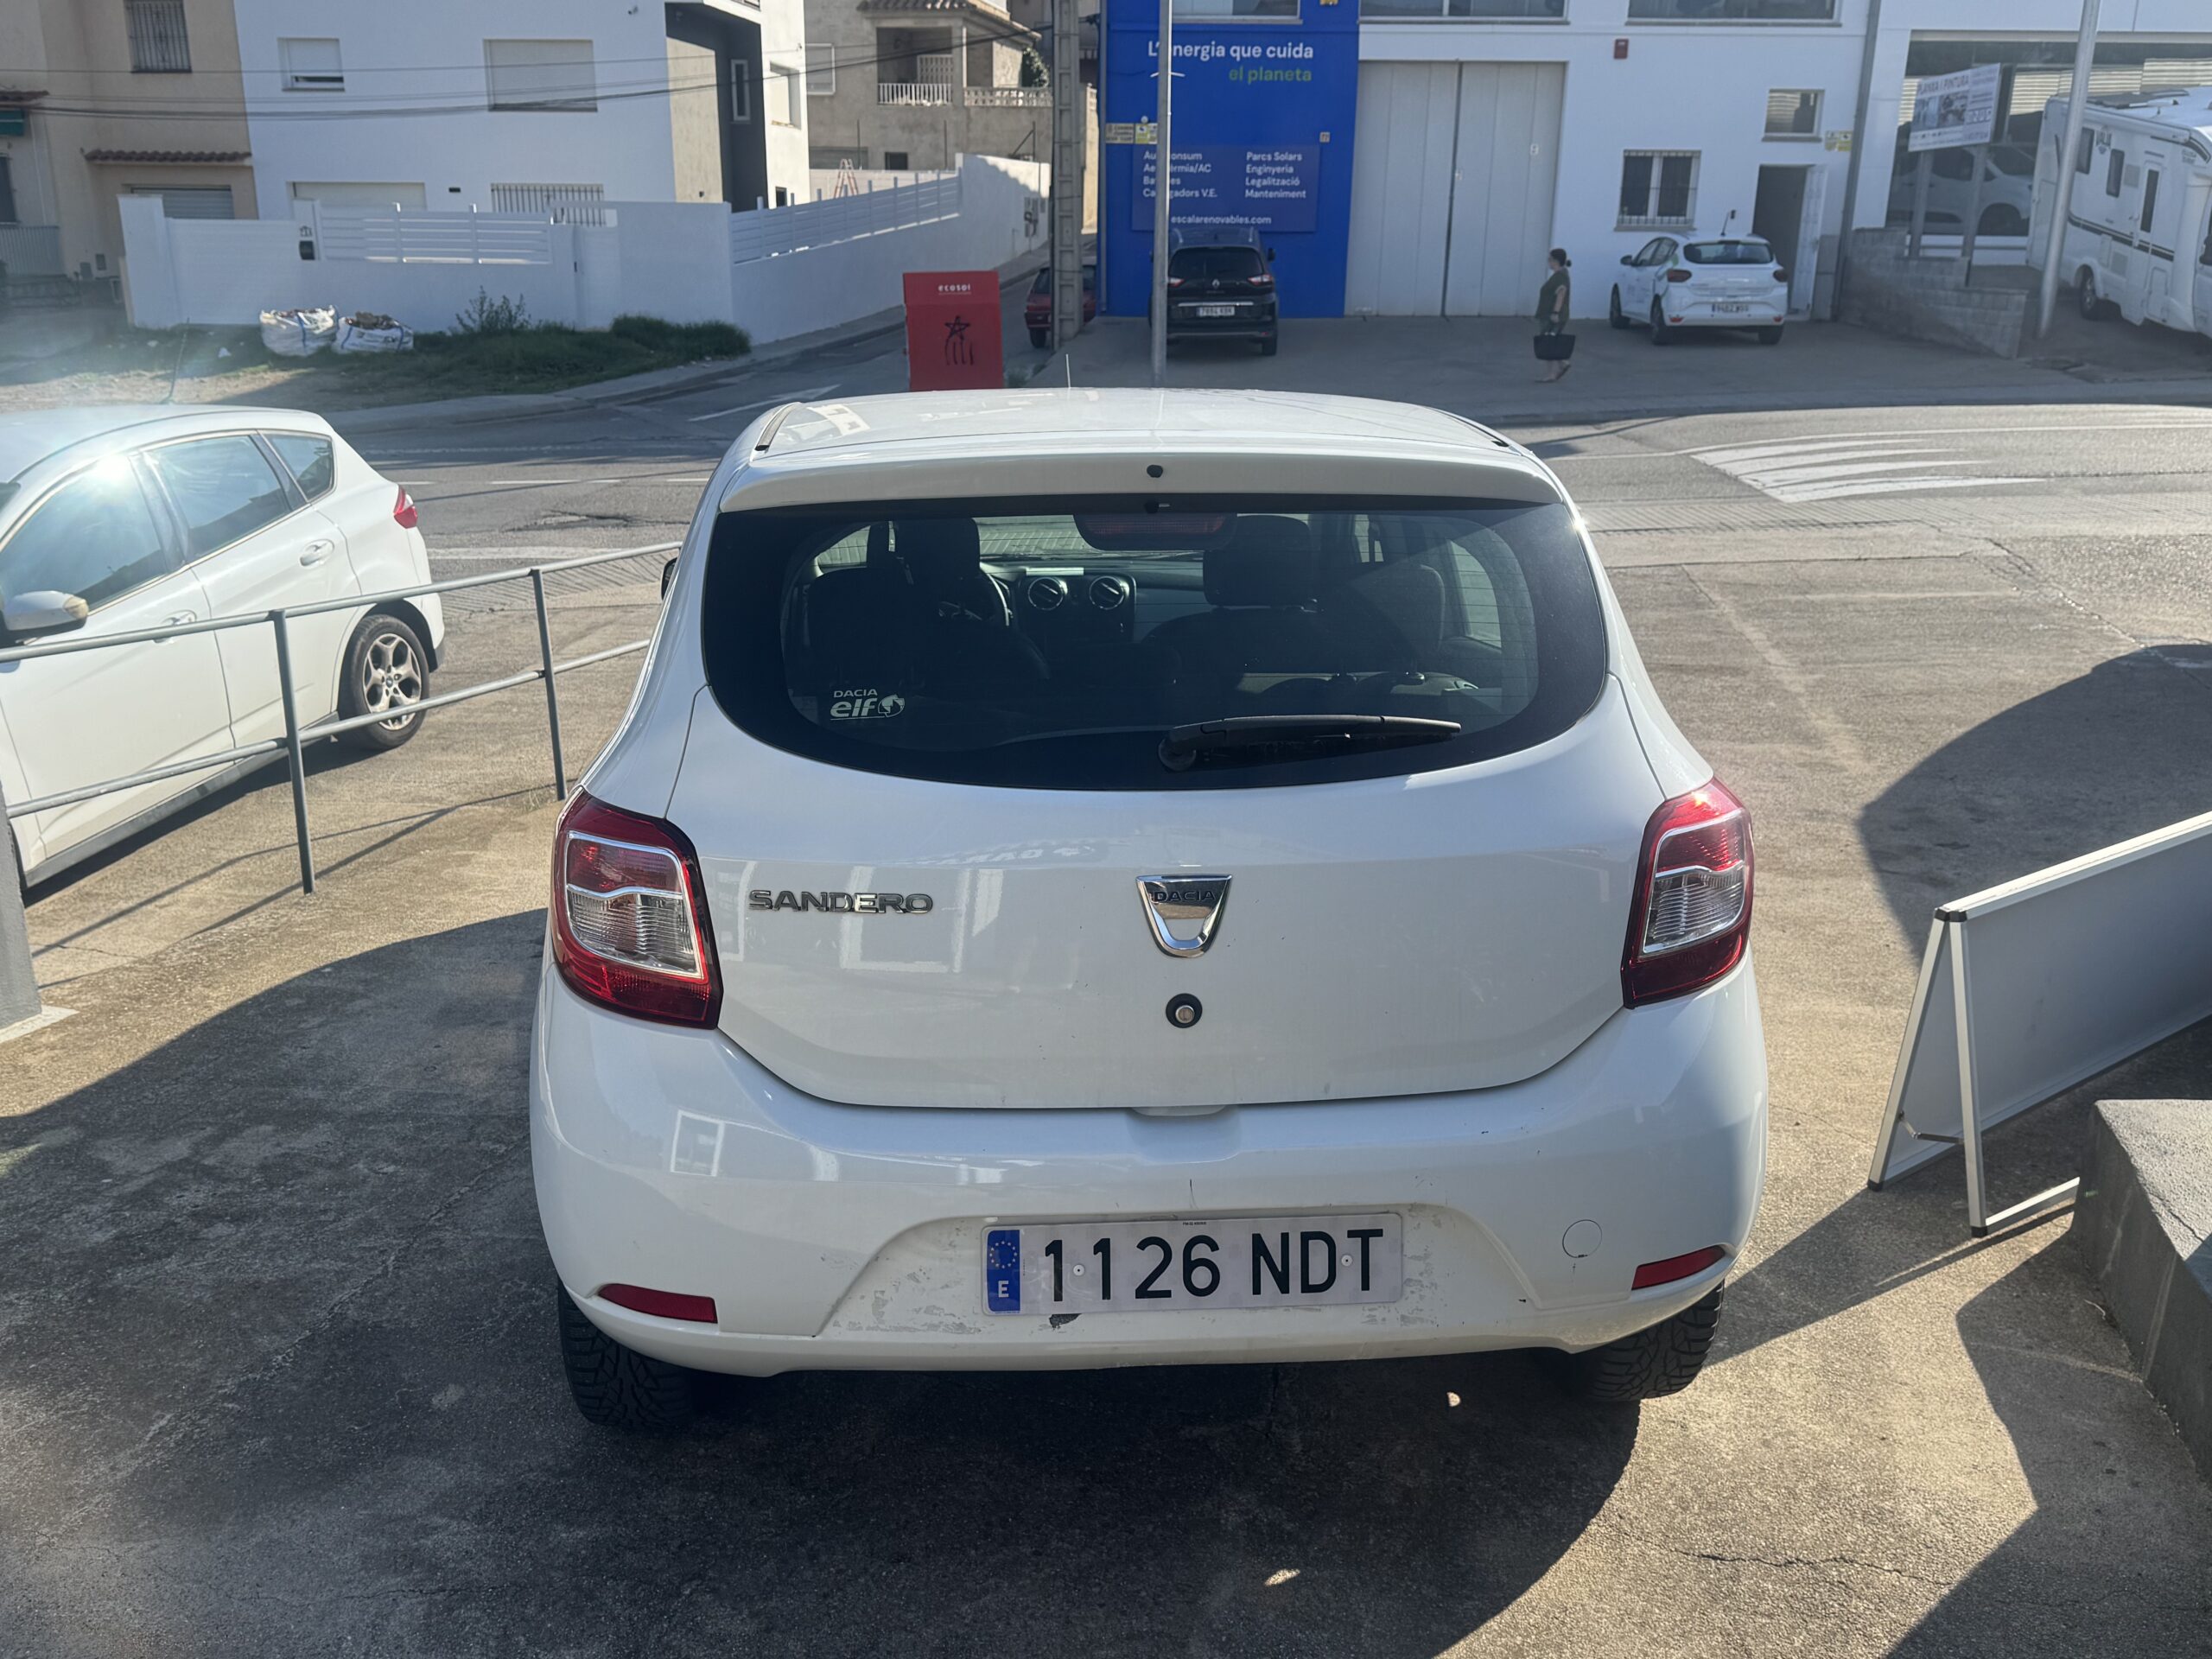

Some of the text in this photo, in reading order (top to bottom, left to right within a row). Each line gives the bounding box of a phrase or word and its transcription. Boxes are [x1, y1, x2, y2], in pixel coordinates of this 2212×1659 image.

[1148, 41, 1313, 61] L'nergia que cuida
[1229, 66, 1313, 85] el planeta
[1143, 150, 1203, 161] Auonsum
[1246, 151, 1303, 161] Parcs Solars
[1246, 164, 1294, 175] Enginyeria
[1245, 176, 1300, 188] Legalització
[1245, 188, 1306, 198] Manteniment
[1171, 214, 1272, 224] escalarenovables.com
[833, 689, 878, 698] DACIA
[830, 697, 878, 718] elf
[748, 889, 933, 913] SANDERO
[1153, 891, 1216, 901] DACIA
[998, 1228, 1383, 1302] E 1126 NDT
